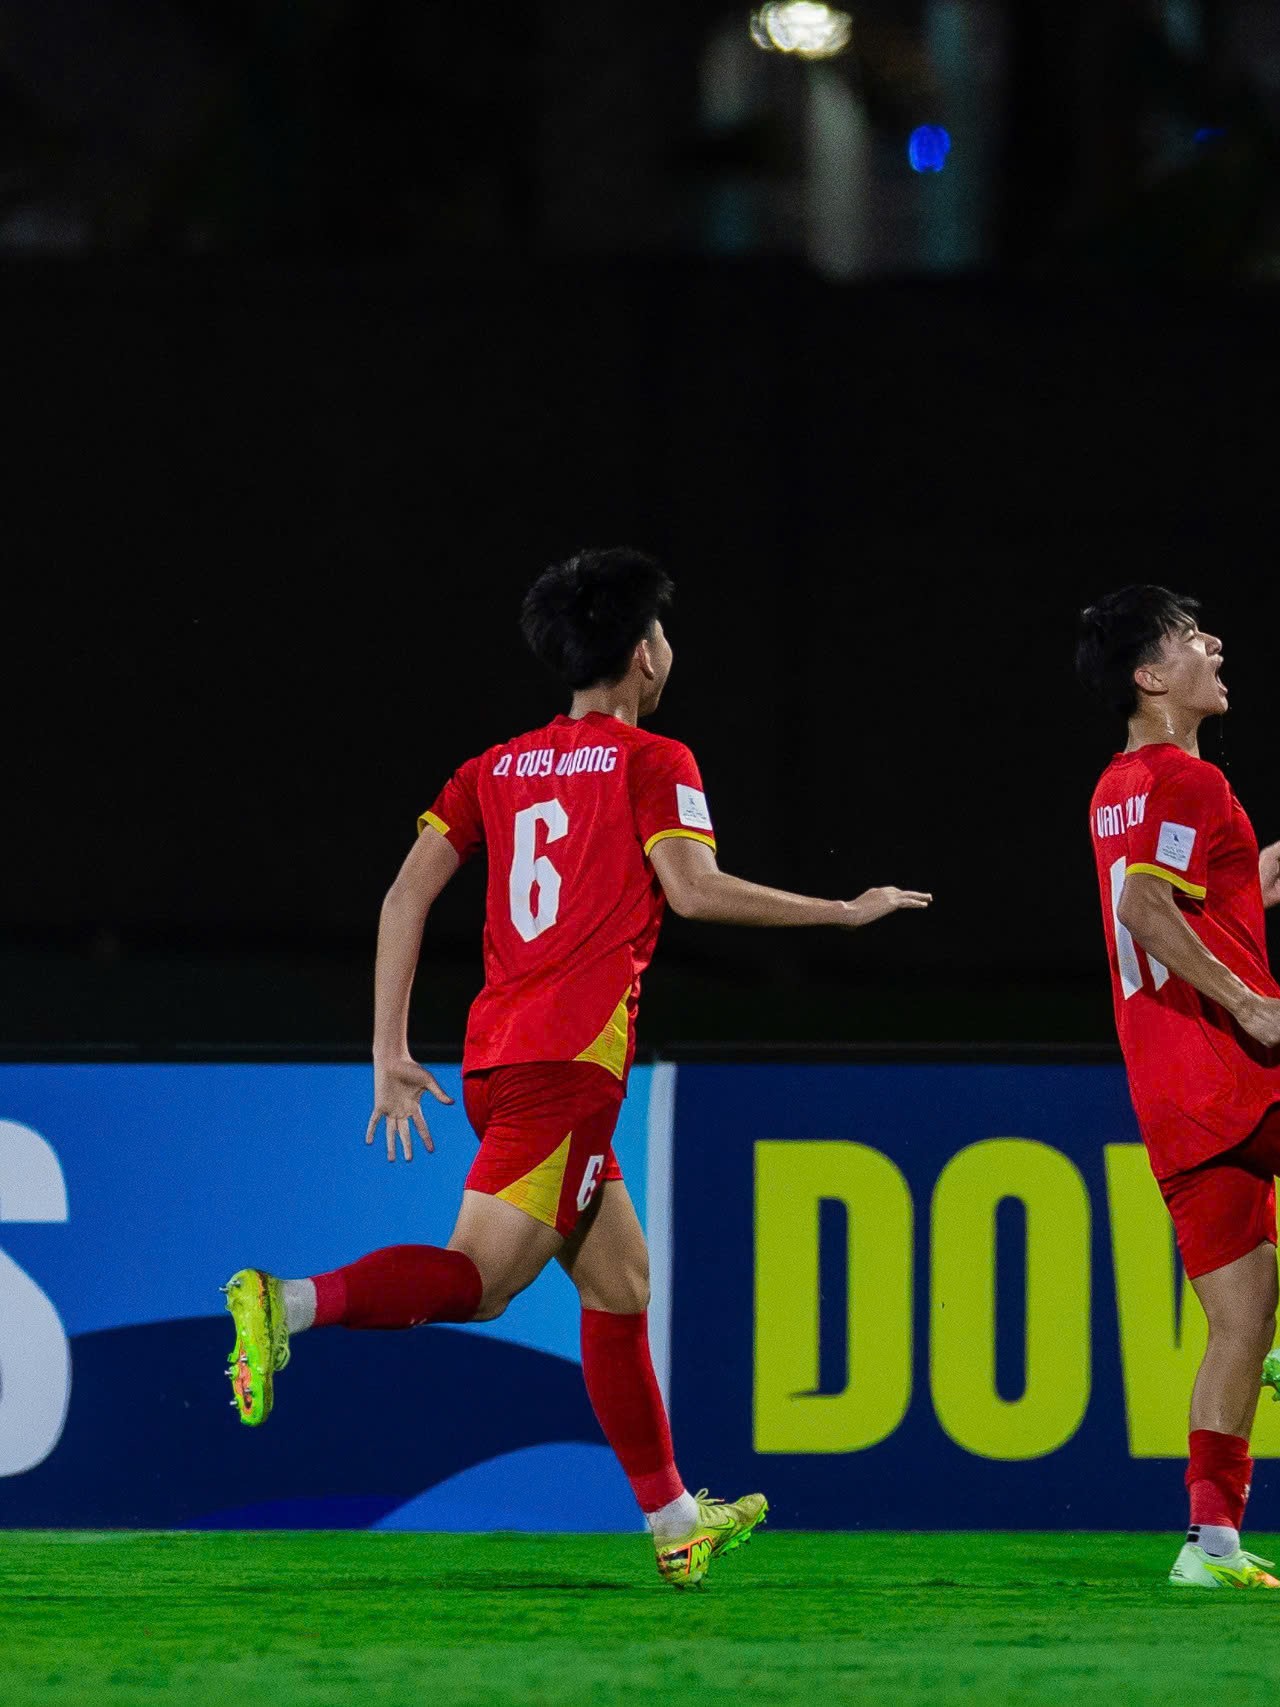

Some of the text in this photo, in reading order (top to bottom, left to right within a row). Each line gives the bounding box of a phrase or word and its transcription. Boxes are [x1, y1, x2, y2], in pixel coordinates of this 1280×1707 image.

[516, 748, 555, 777] QUY
[1097, 803, 1125, 839] VAN
[509, 798, 568, 943] 6
[576, 1154, 604, 1212] 6
